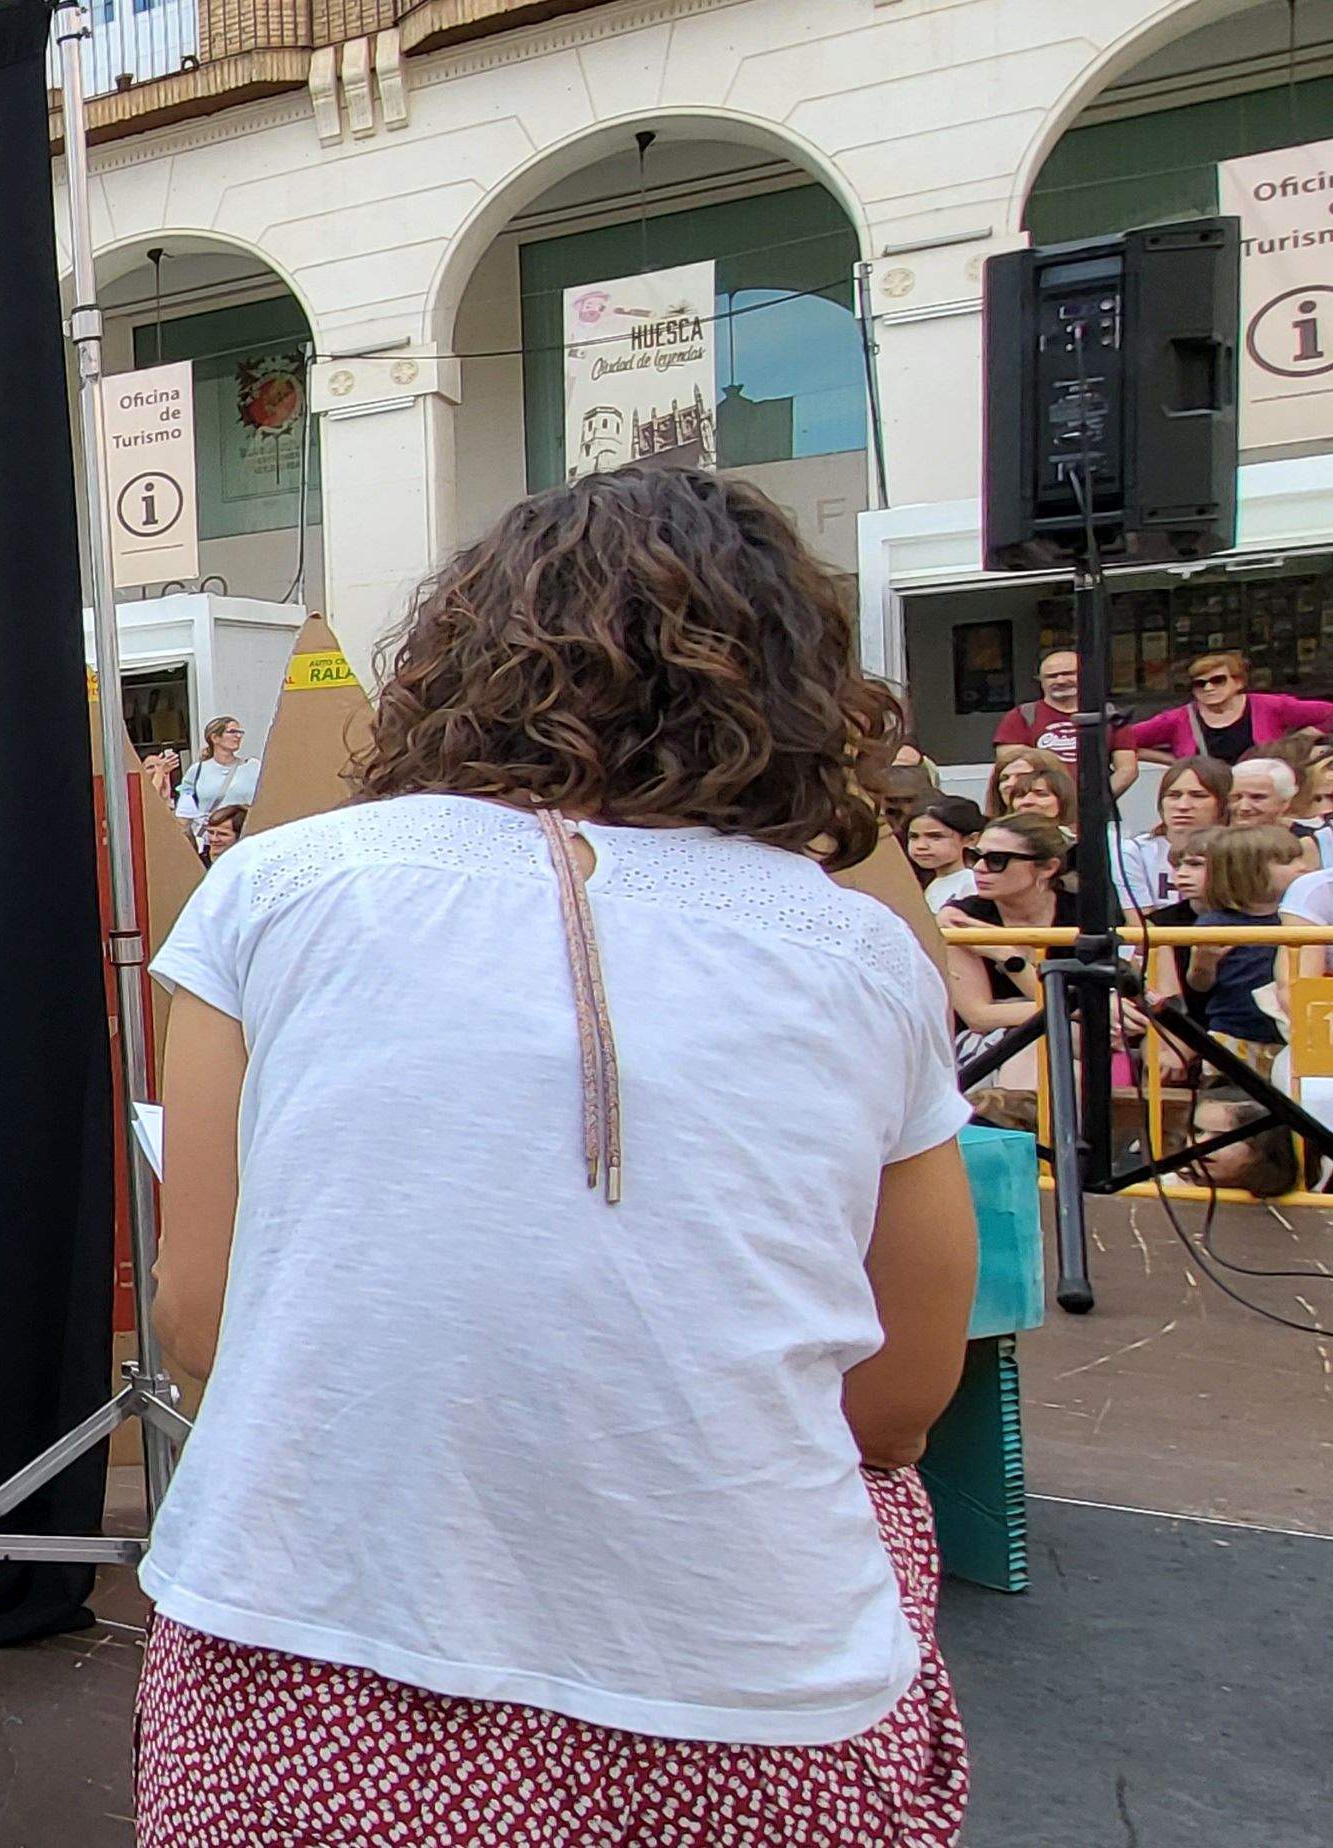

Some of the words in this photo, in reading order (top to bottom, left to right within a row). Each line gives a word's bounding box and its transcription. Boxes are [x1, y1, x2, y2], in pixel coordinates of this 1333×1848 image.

[1253, 170, 1333, 202] Ofici
[631, 315, 704, 351] HUESCA
[591, 355, 634, 381] Ciudad
[636, 352, 652, 369] de
[119, 388, 180, 410] Oficina
[159, 406, 181, 422] de
[112, 428, 182, 449] Turismo
